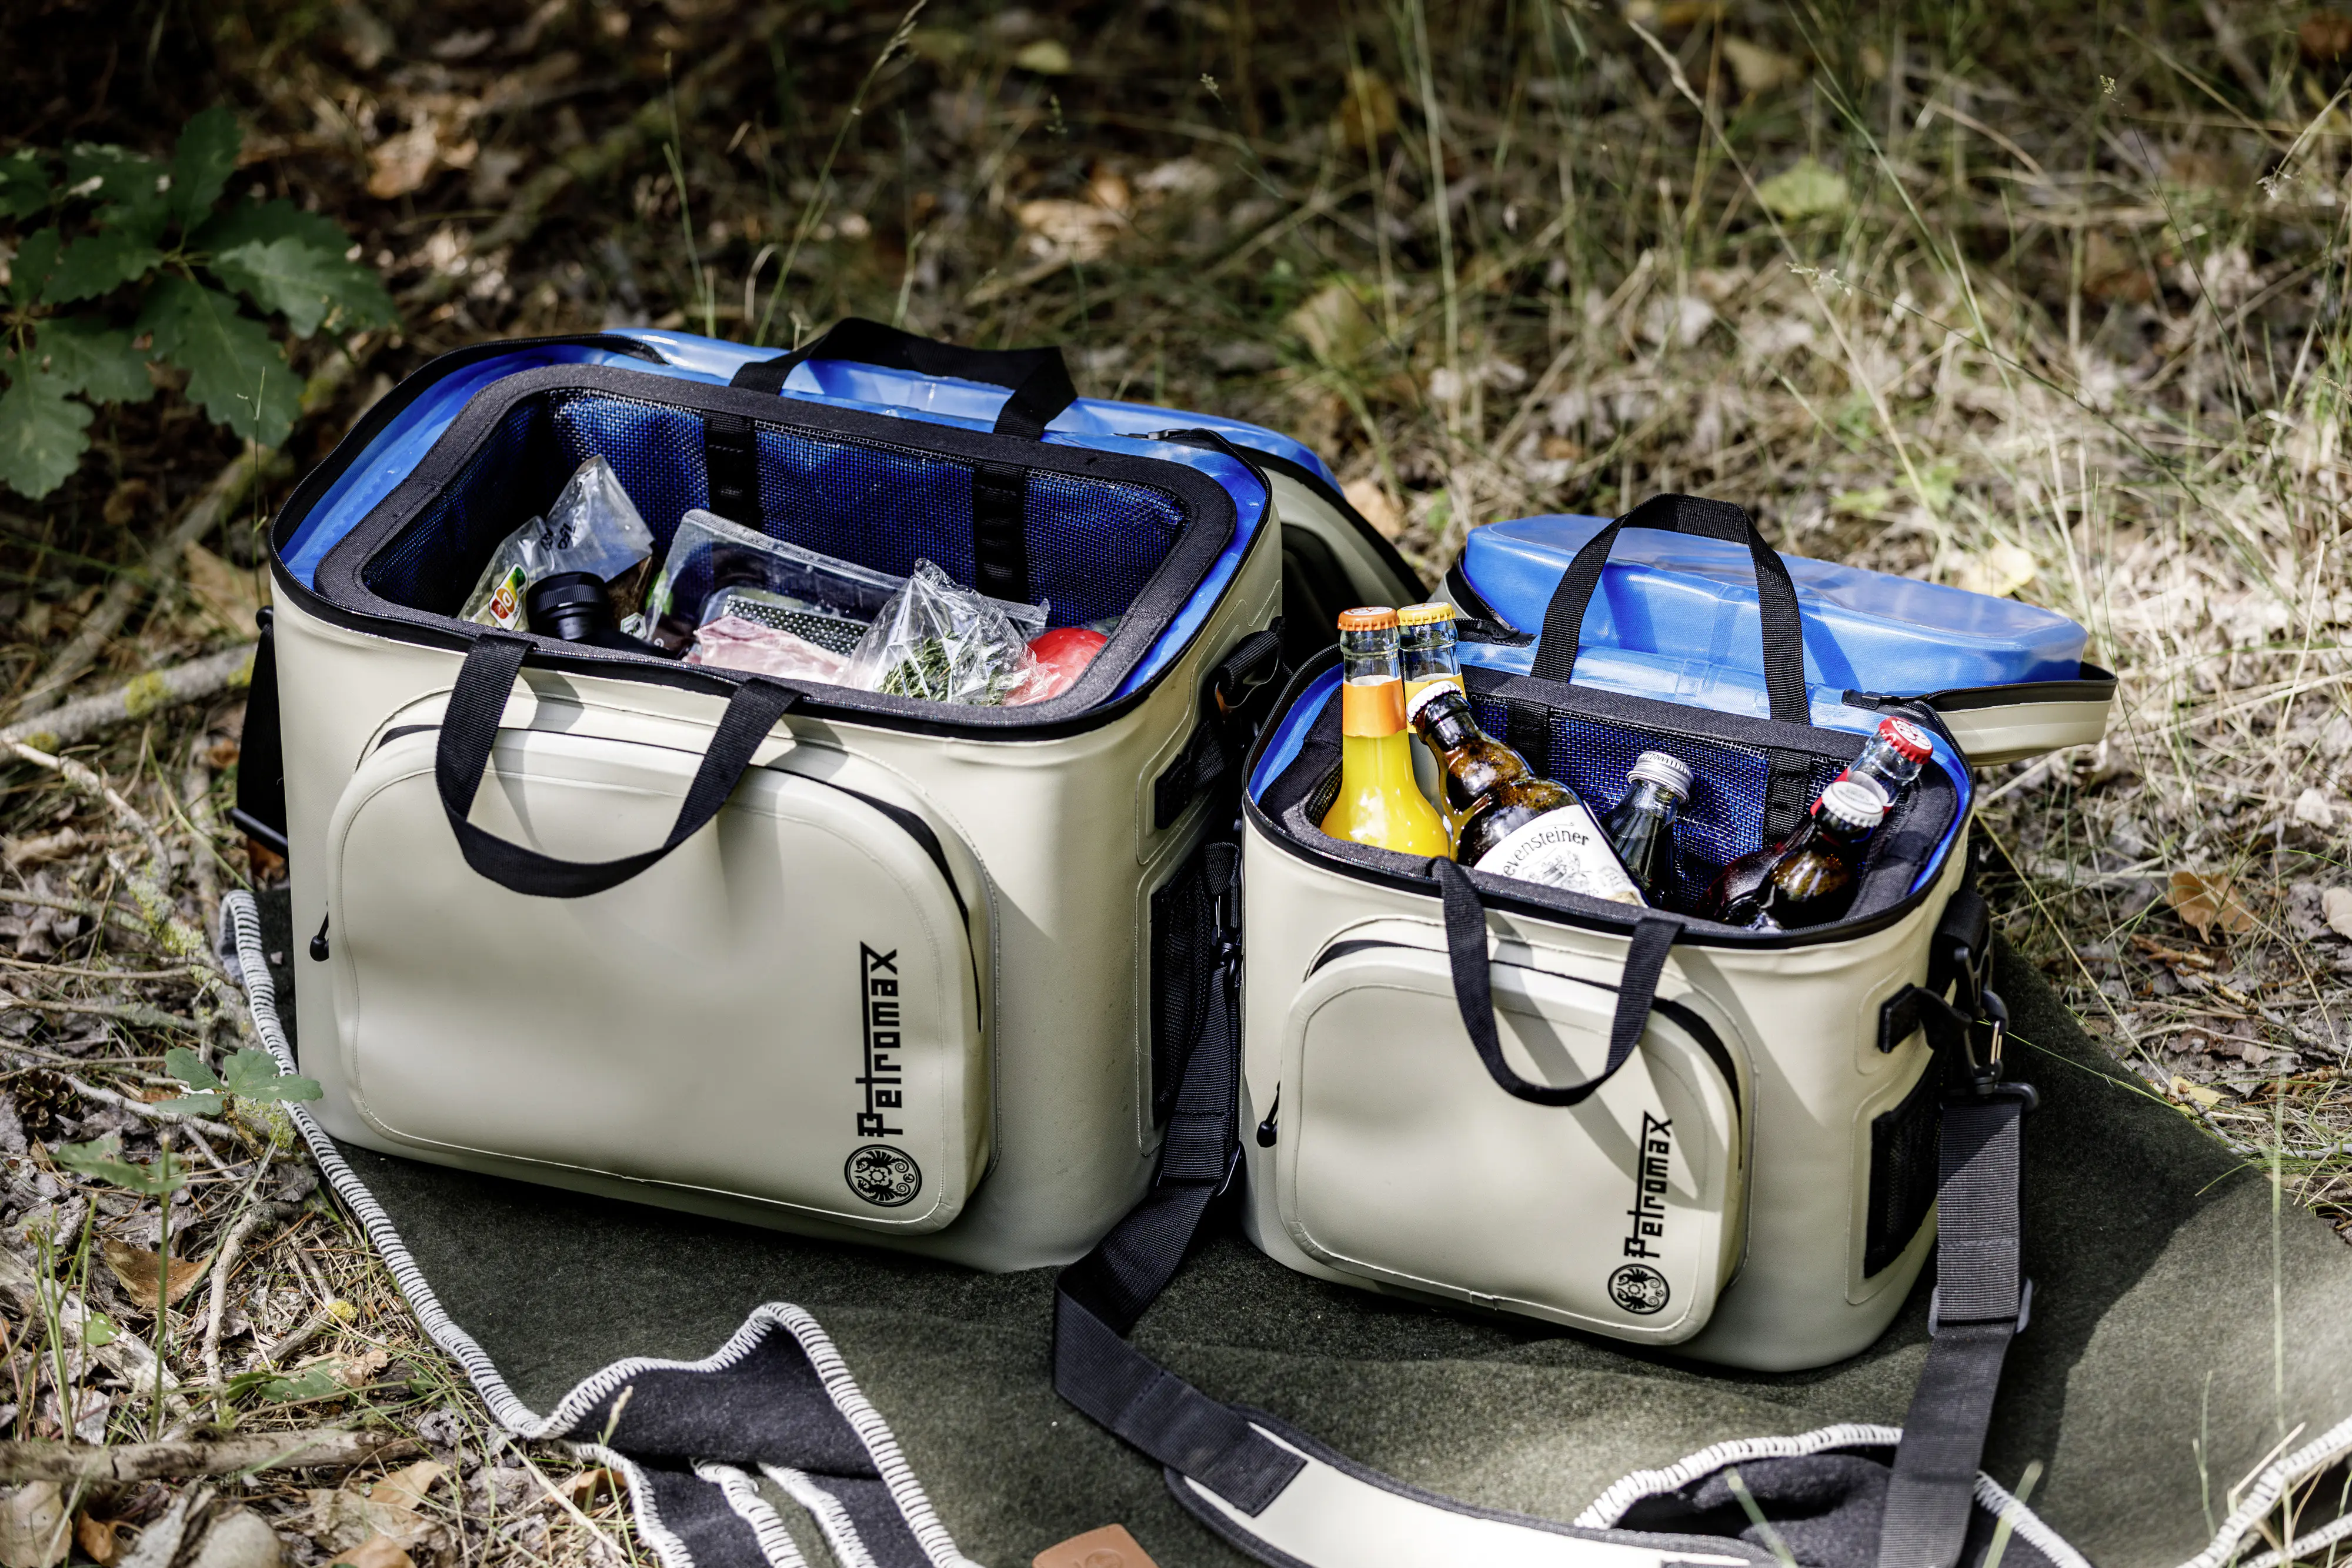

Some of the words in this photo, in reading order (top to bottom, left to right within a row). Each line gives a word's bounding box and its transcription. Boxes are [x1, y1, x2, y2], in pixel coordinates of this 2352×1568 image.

[1502, 826, 1589, 876] evensteiner
[855, 940, 903, 1137] Petromax
[1623, 1109, 1673, 1258] Petromax
